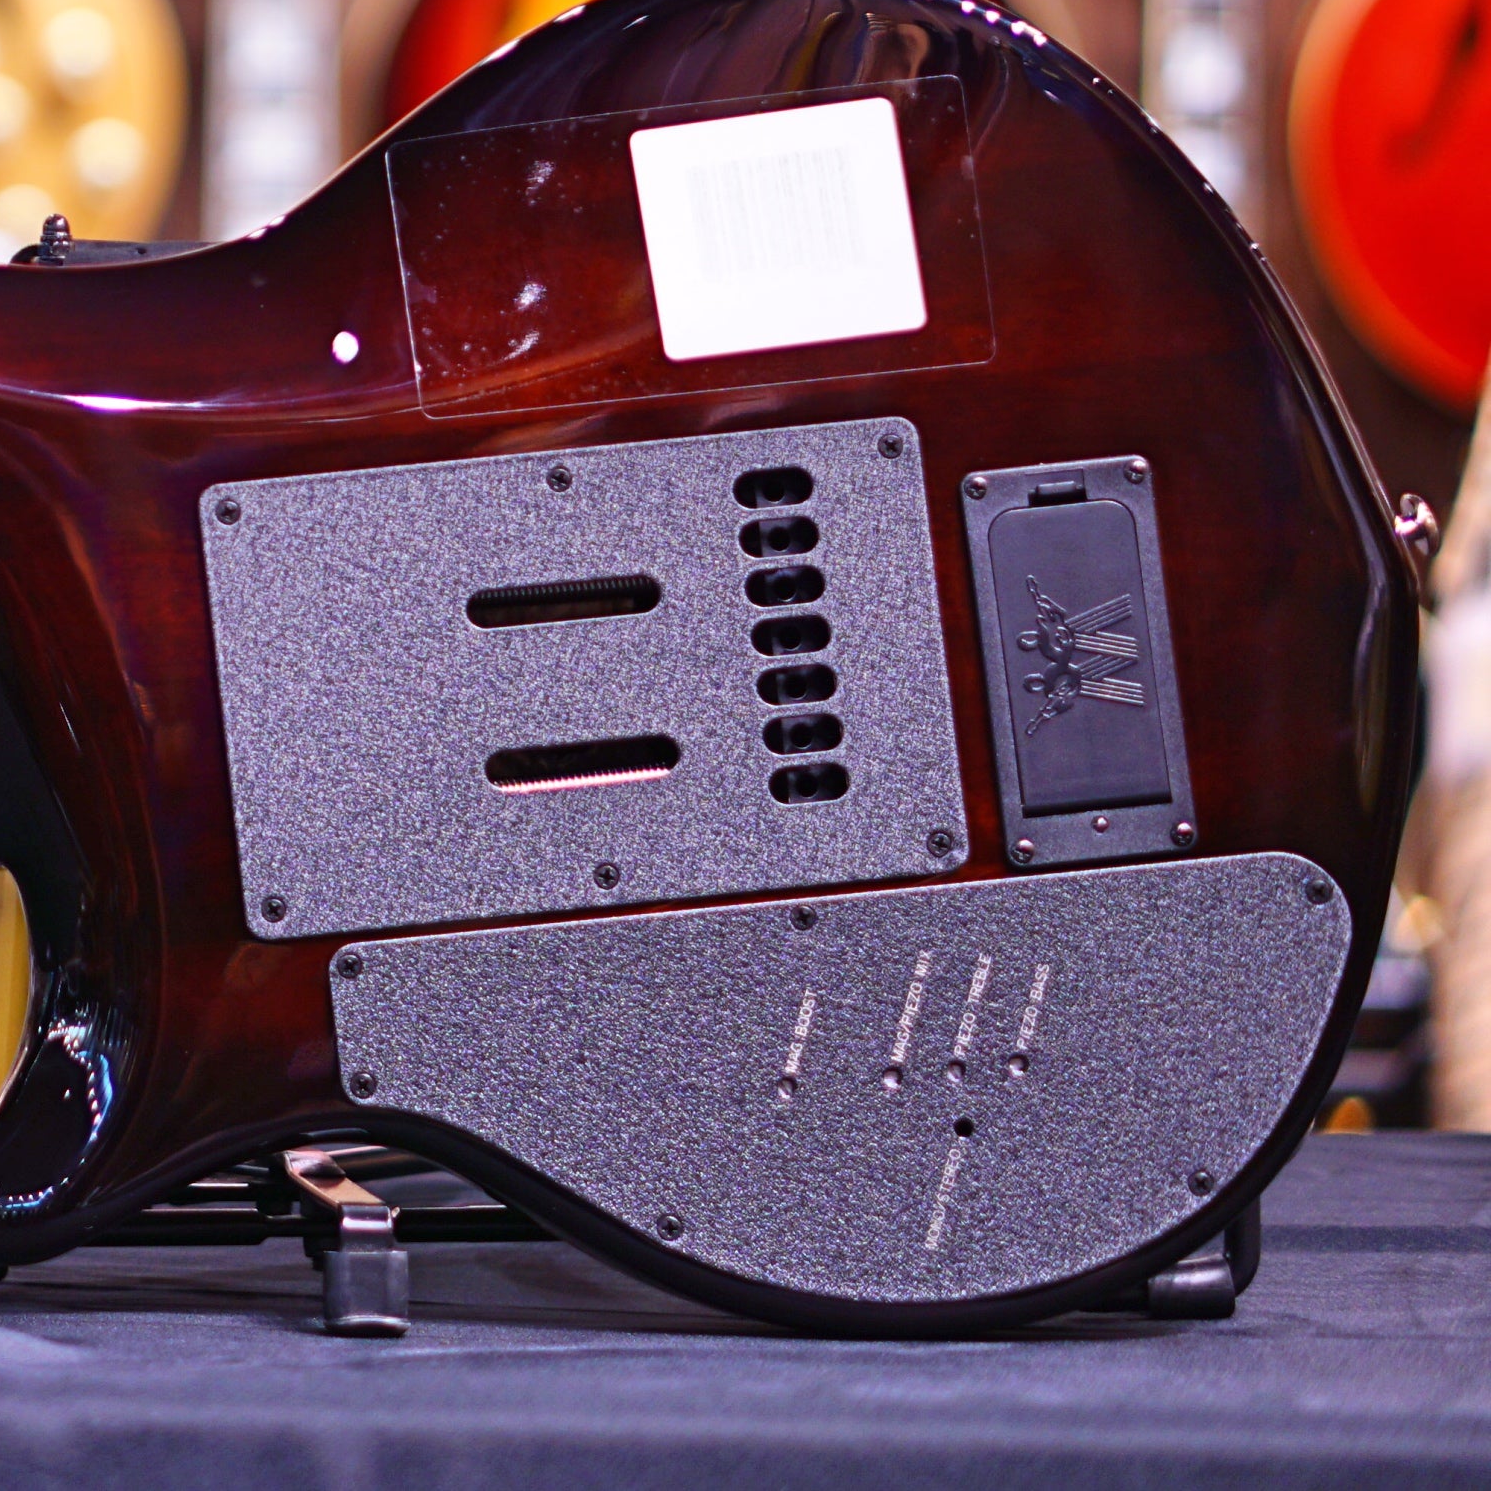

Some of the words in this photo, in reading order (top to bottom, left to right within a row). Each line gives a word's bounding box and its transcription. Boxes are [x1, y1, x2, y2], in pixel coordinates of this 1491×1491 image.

[785, 1041, 803, 1074] MAG
[795, 988, 818, 1038] BOOST
[891, 982, 923, 1063] MAG/PIEZO
[914, 949, 933, 977] MIX
[954, 1012, 977, 1057] PIEZO
[967, 953, 993, 1004] TREBLE
[1016, 1006, 1038, 1049] PIEZO
[1029, 963, 1050, 1003] BASS
[924, 1149, 960, 1250] MONO/STEREO
